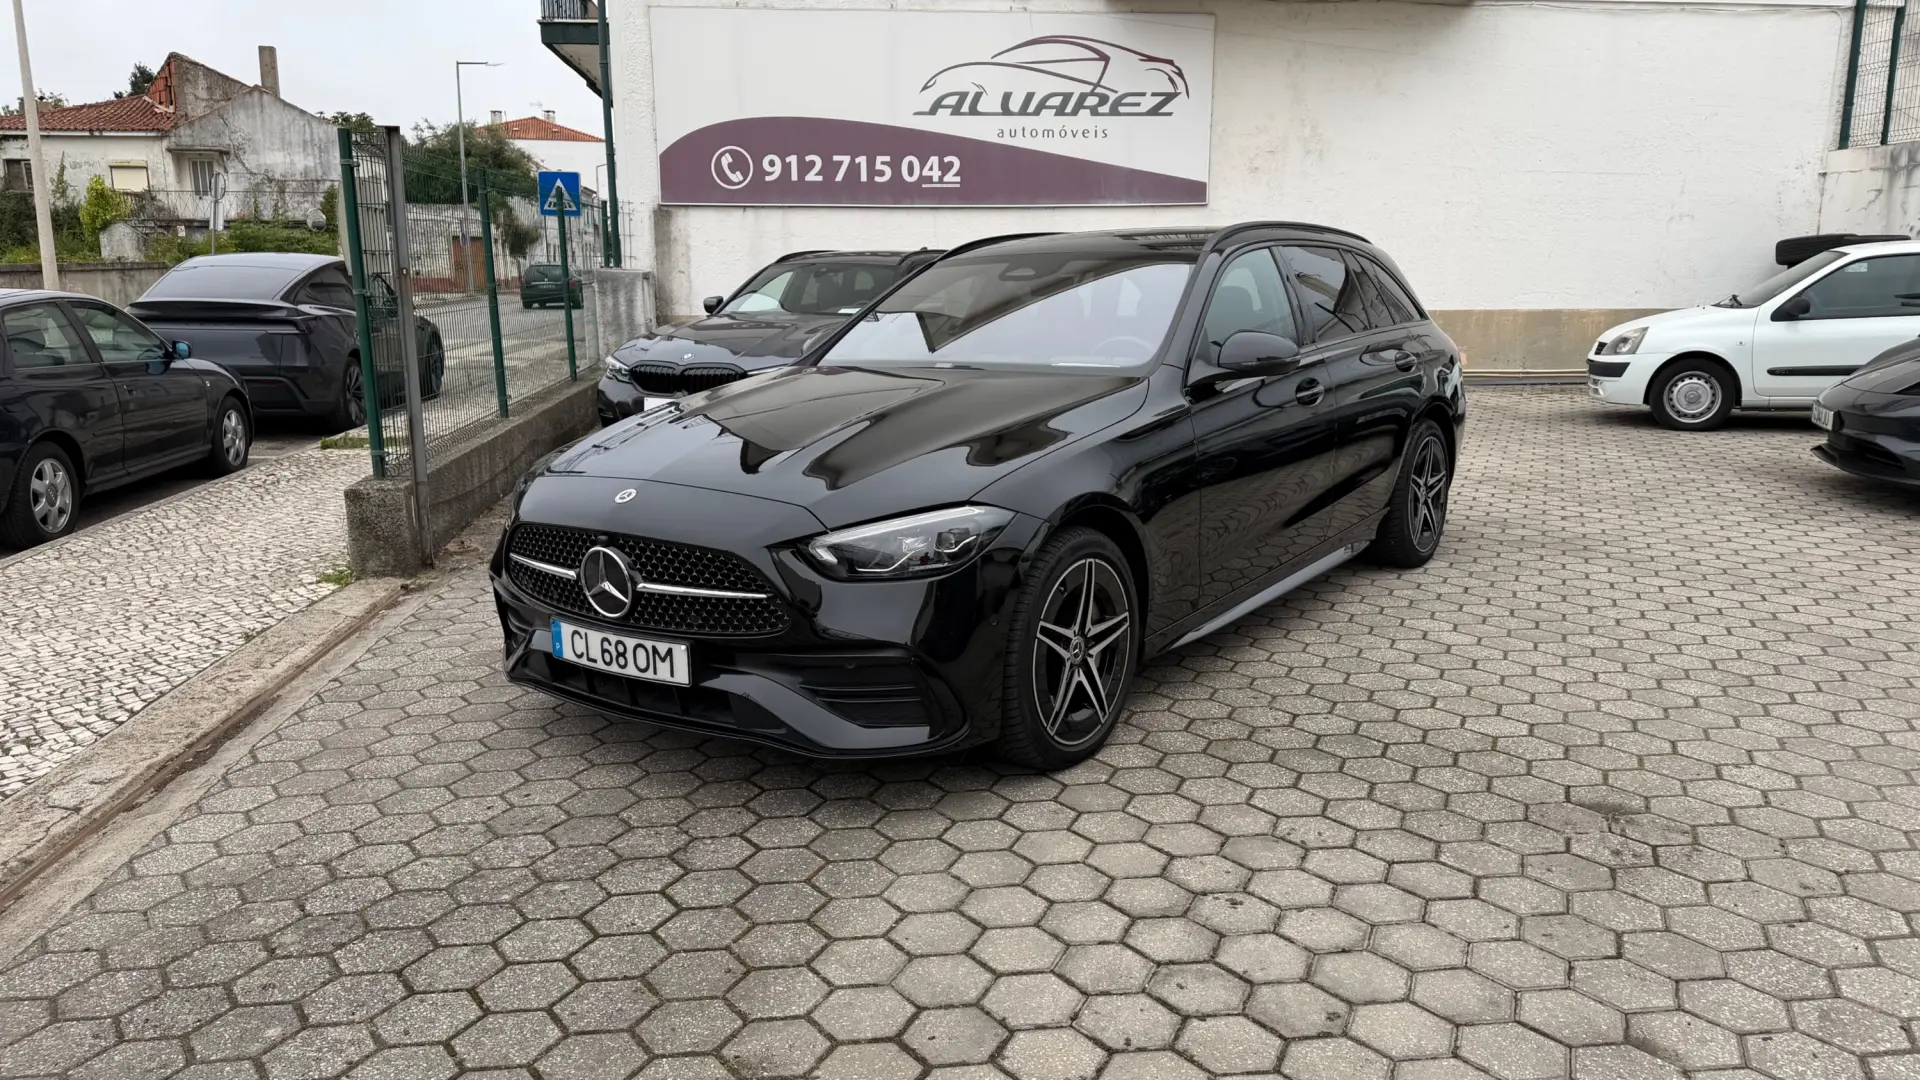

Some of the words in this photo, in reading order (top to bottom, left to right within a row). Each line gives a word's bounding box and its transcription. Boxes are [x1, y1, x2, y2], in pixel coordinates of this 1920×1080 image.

[997, 125, 1108, 139] automóveis
[762, 154, 823, 182] 912
[832, 155, 892, 182] 715
[901, 155, 961, 183] 042
